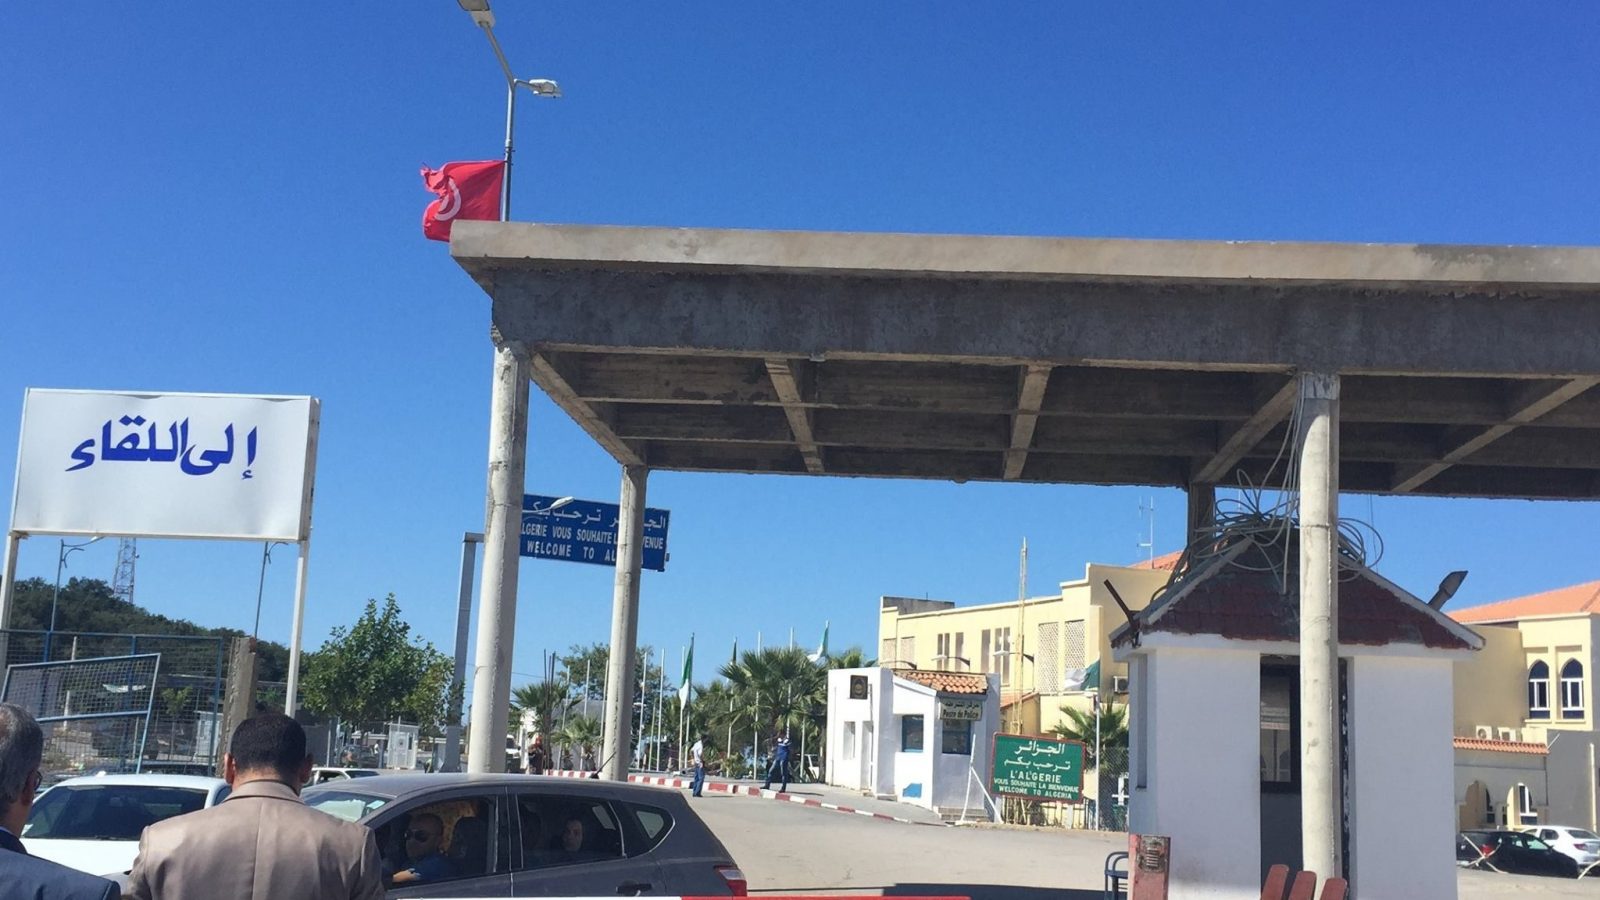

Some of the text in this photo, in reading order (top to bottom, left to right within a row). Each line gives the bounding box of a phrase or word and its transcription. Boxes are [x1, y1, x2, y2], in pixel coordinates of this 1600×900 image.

[65, 414, 257, 480] إلى اللقاء
[521, 522, 548, 537] LGERIE
[552, 525, 572, 540] VOUS
[576, 528, 612, 545] SOUHAITE
[527, 540, 572, 557] WELCOME
[583, 546, 595, 560] TO
[1014, 740, 1066, 757] الجزائر
[1004, 757, 1071, 772] ترحب بكم
[999, 786, 1028, 795] WELCOME
[1045, 790, 1072, 799] ALGERIA
